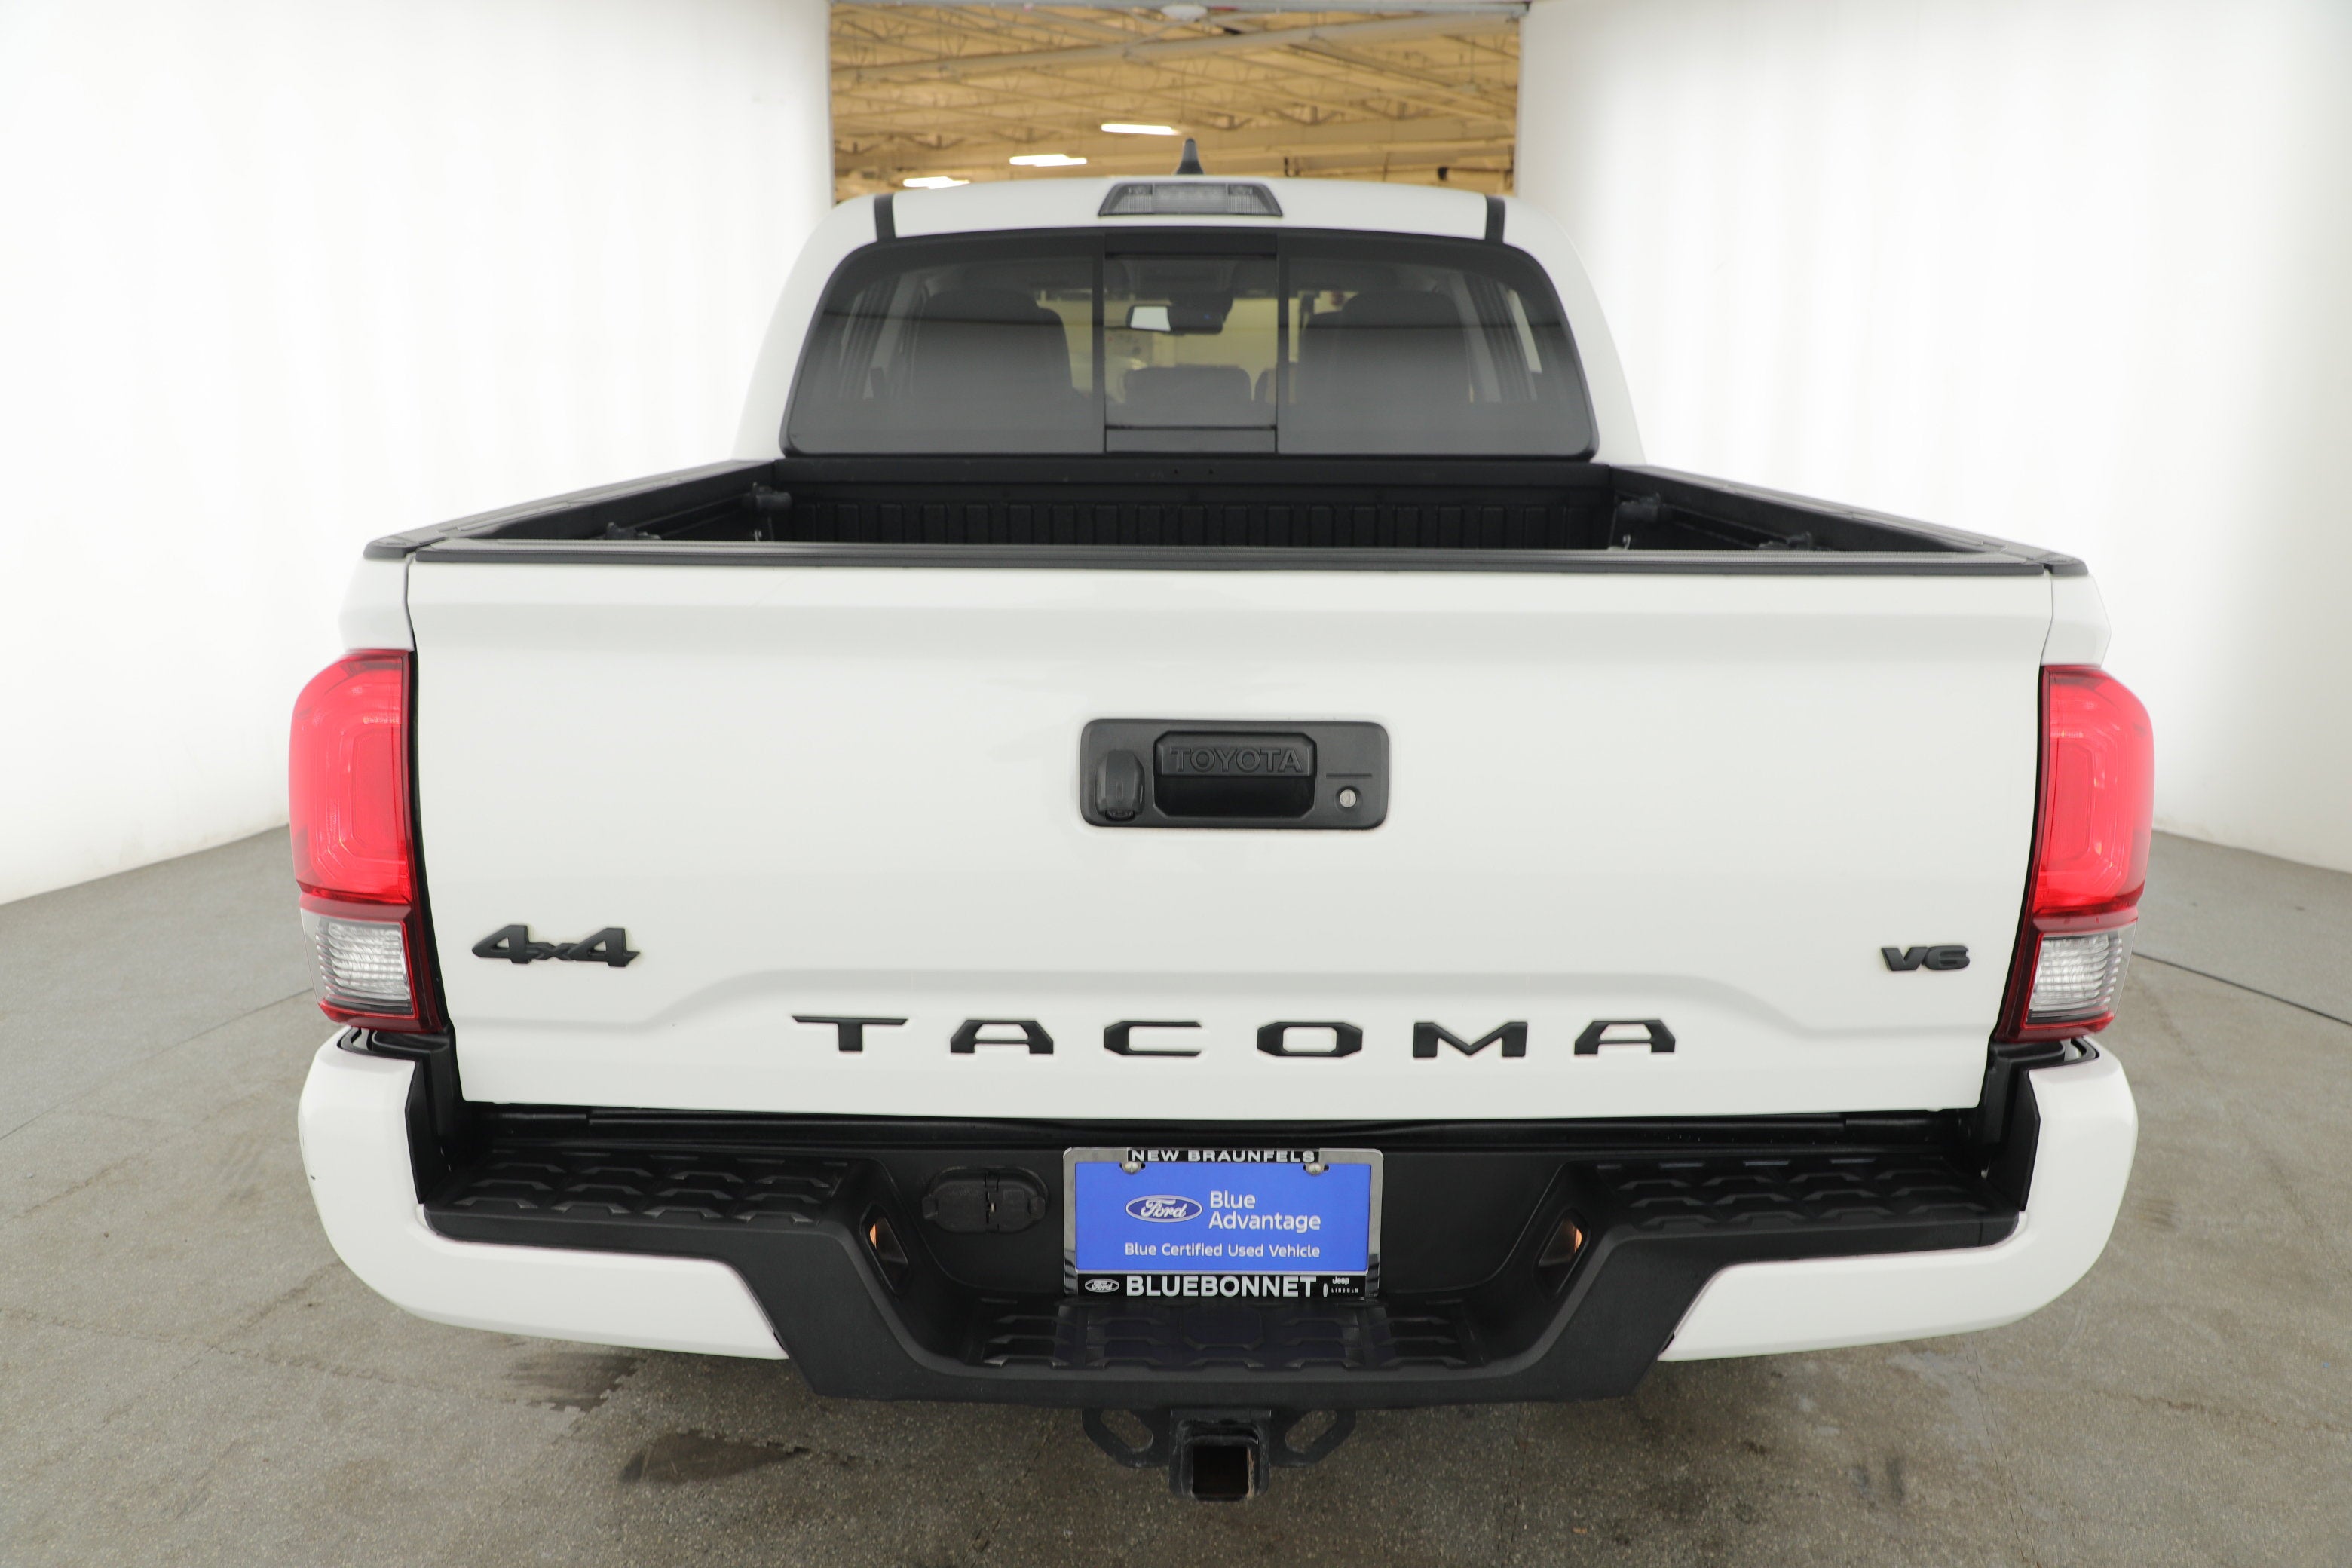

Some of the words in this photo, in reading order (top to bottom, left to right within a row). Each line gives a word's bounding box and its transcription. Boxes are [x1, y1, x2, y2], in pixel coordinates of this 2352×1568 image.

[1171, 746, 1303, 773] TOYOTA
[1881, 945, 1970, 972] V6
[792, 1015, 1676, 1058] TACOMA
[1132, 1150, 1179, 1162] NEW
[1188, 1150, 1315, 1162] BRAUNFELS
[1140, 1199, 1187, 1218] Ford
[1209, 1190, 1256, 1208] Blue
[1208, 1211, 1321, 1233] Advantage
[1125, 1242, 1156, 1256] Blue
[1162, 1242, 1223, 1257] Certified
[1228, 1243, 1263, 1257] Used
[1269, 1243, 1321, 1258] Vehicle
[1126, 1275, 1317, 1297] BLUEBONNET
[1332, 1276, 1350, 1285] Jeep
